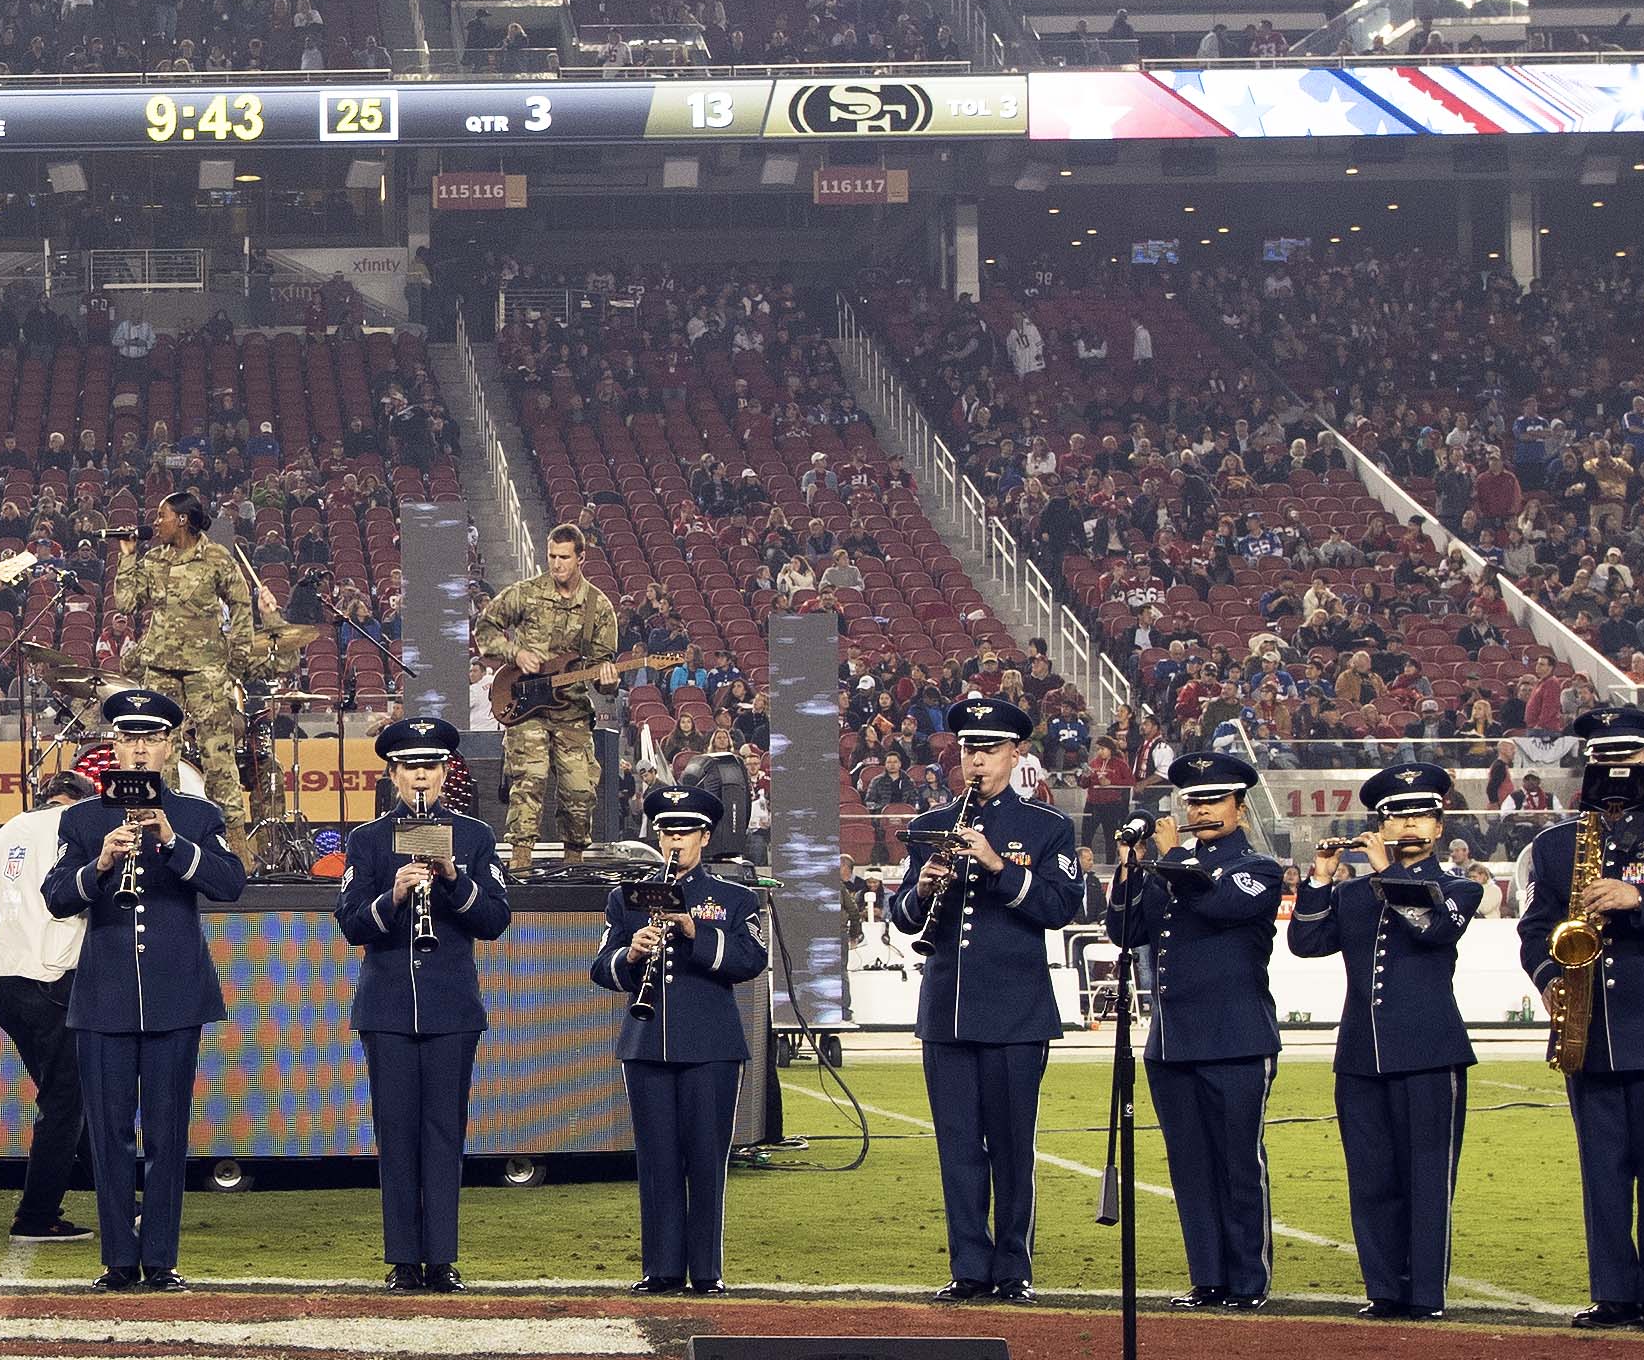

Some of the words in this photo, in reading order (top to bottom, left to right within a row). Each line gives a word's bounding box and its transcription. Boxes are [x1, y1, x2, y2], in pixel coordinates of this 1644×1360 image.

[335, 99, 383, 132] 25
[465, 117, 509, 134] QTR
[524, 96, 553, 132] 3
[687, 93, 734, 129] 13
[947, 99, 991, 118] TOL
[999, 94, 1018, 119] 3
[145, 94, 264, 142] 9:43
[440, 185, 470, 199] 115
[473, 185, 504, 199] 116
[821, 180, 851, 193] 116
[854, 180, 885, 193] 117
[353, 257, 401, 275] xfinity
[1035, 272, 1053, 285] 98
[1136, 588, 1158, 601] 56
[1021, 768, 1036, 788] 10
[1287, 789, 1353, 817] 117
